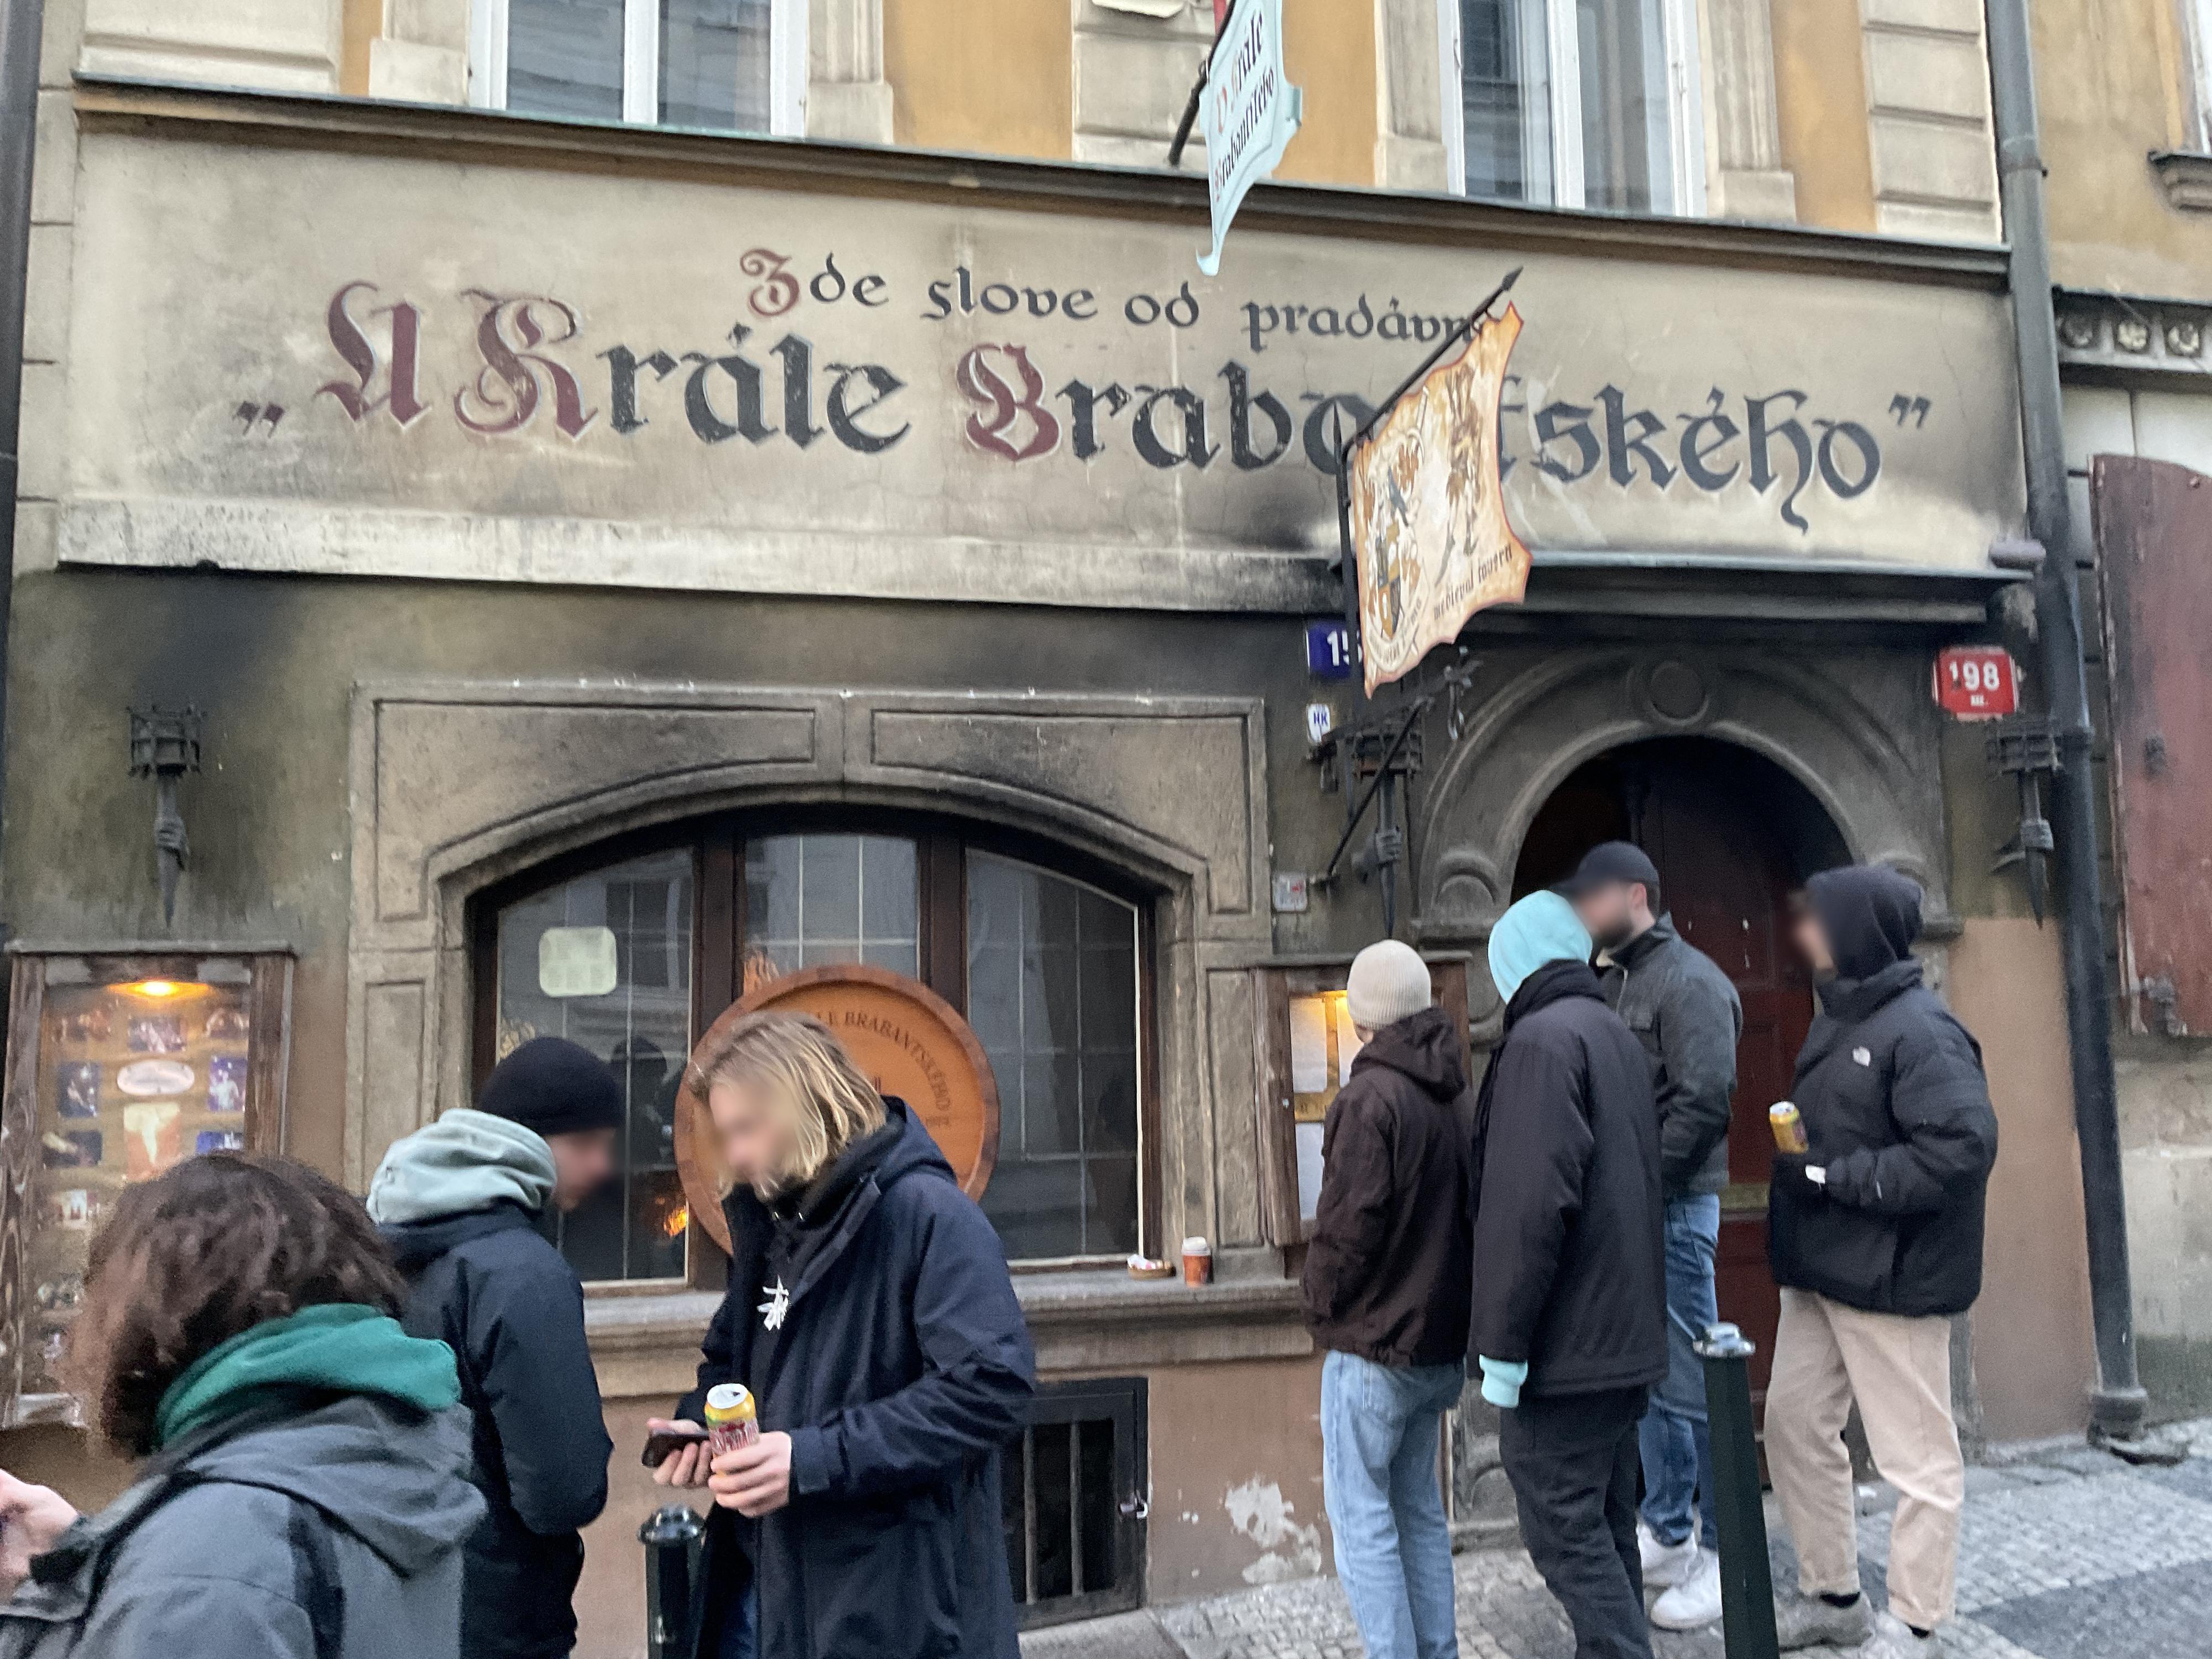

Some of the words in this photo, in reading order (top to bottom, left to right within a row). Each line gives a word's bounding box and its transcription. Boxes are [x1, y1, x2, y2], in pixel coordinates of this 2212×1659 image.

[740, 248, 889, 319] Zde
[920, 265, 1098, 320] slove
[1125, 281, 1199, 328] od
[1240, 294, 1473, 353] pradávn
[453, 286, 911, 455] Krále
[1949, 660, 2000, 691] 198
